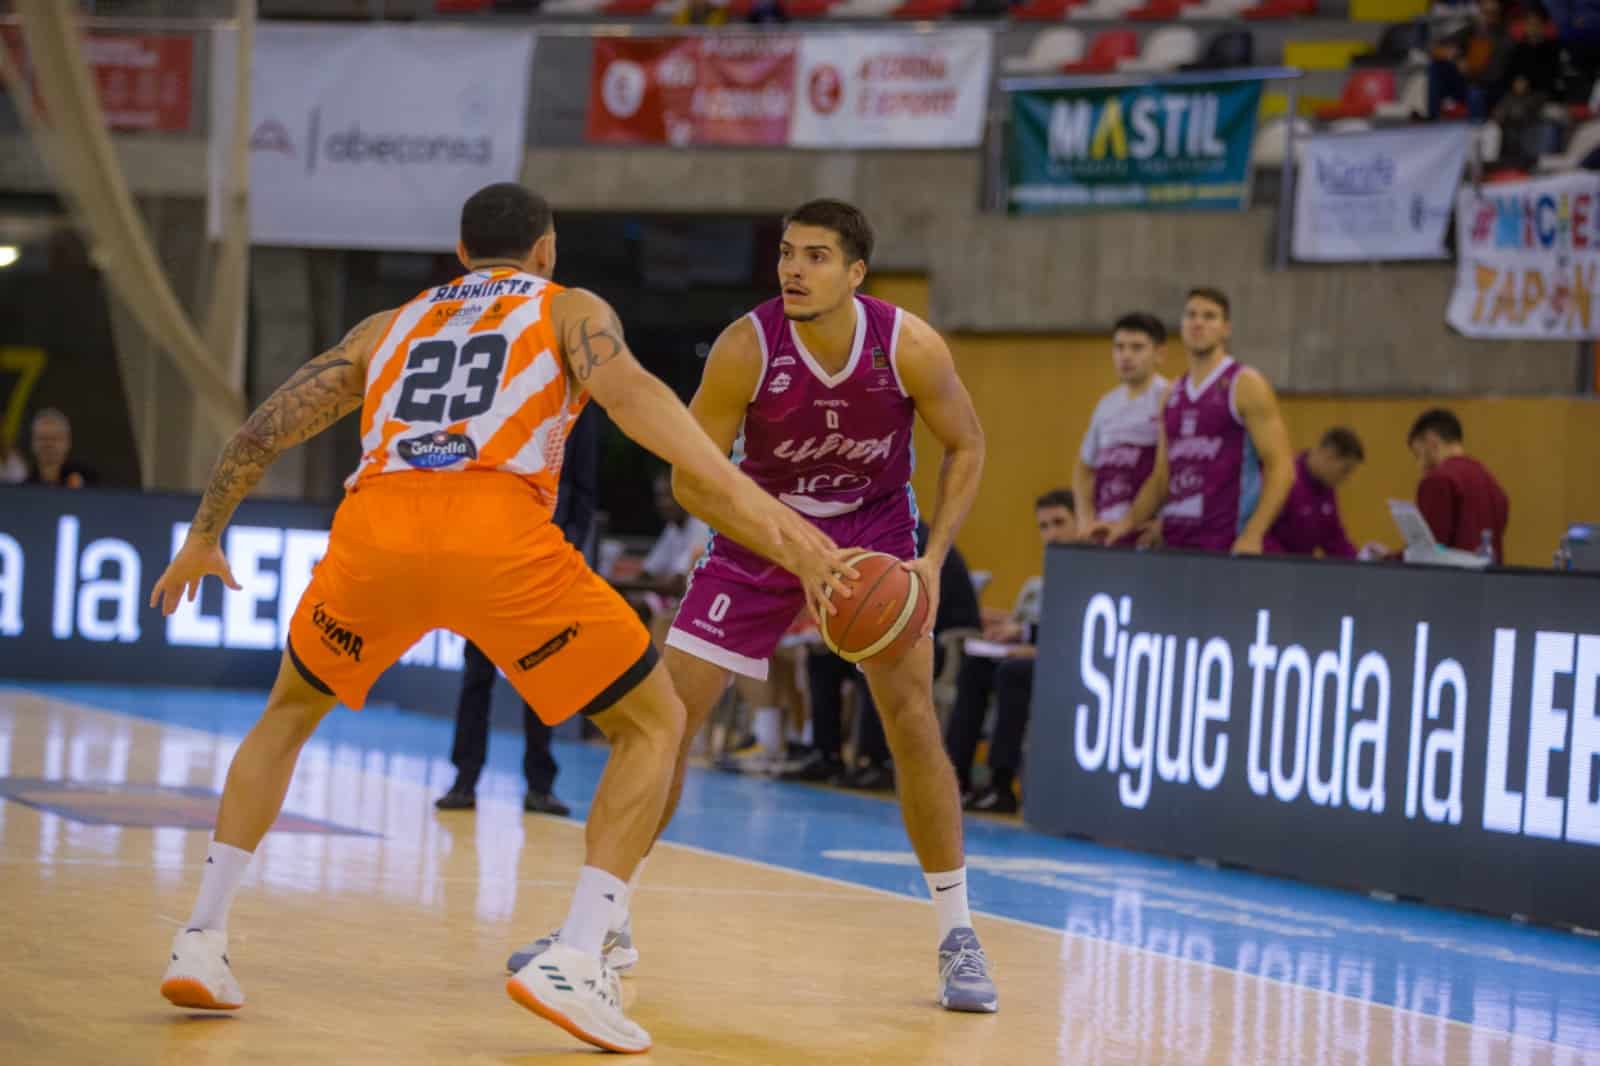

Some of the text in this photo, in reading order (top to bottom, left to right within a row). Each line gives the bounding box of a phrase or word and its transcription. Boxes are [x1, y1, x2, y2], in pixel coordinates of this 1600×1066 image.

[1047, 91, 1226, 160] MASTIL
[393, 333, 509, 423] 23
[52, 514, 142, 643] la
[708, 592, 731, 622] 0
[1074, 592, 1234, 810] Sigue
[1247, 609, 1391, 814] toda
[1405, 621, 1468, 825] la
